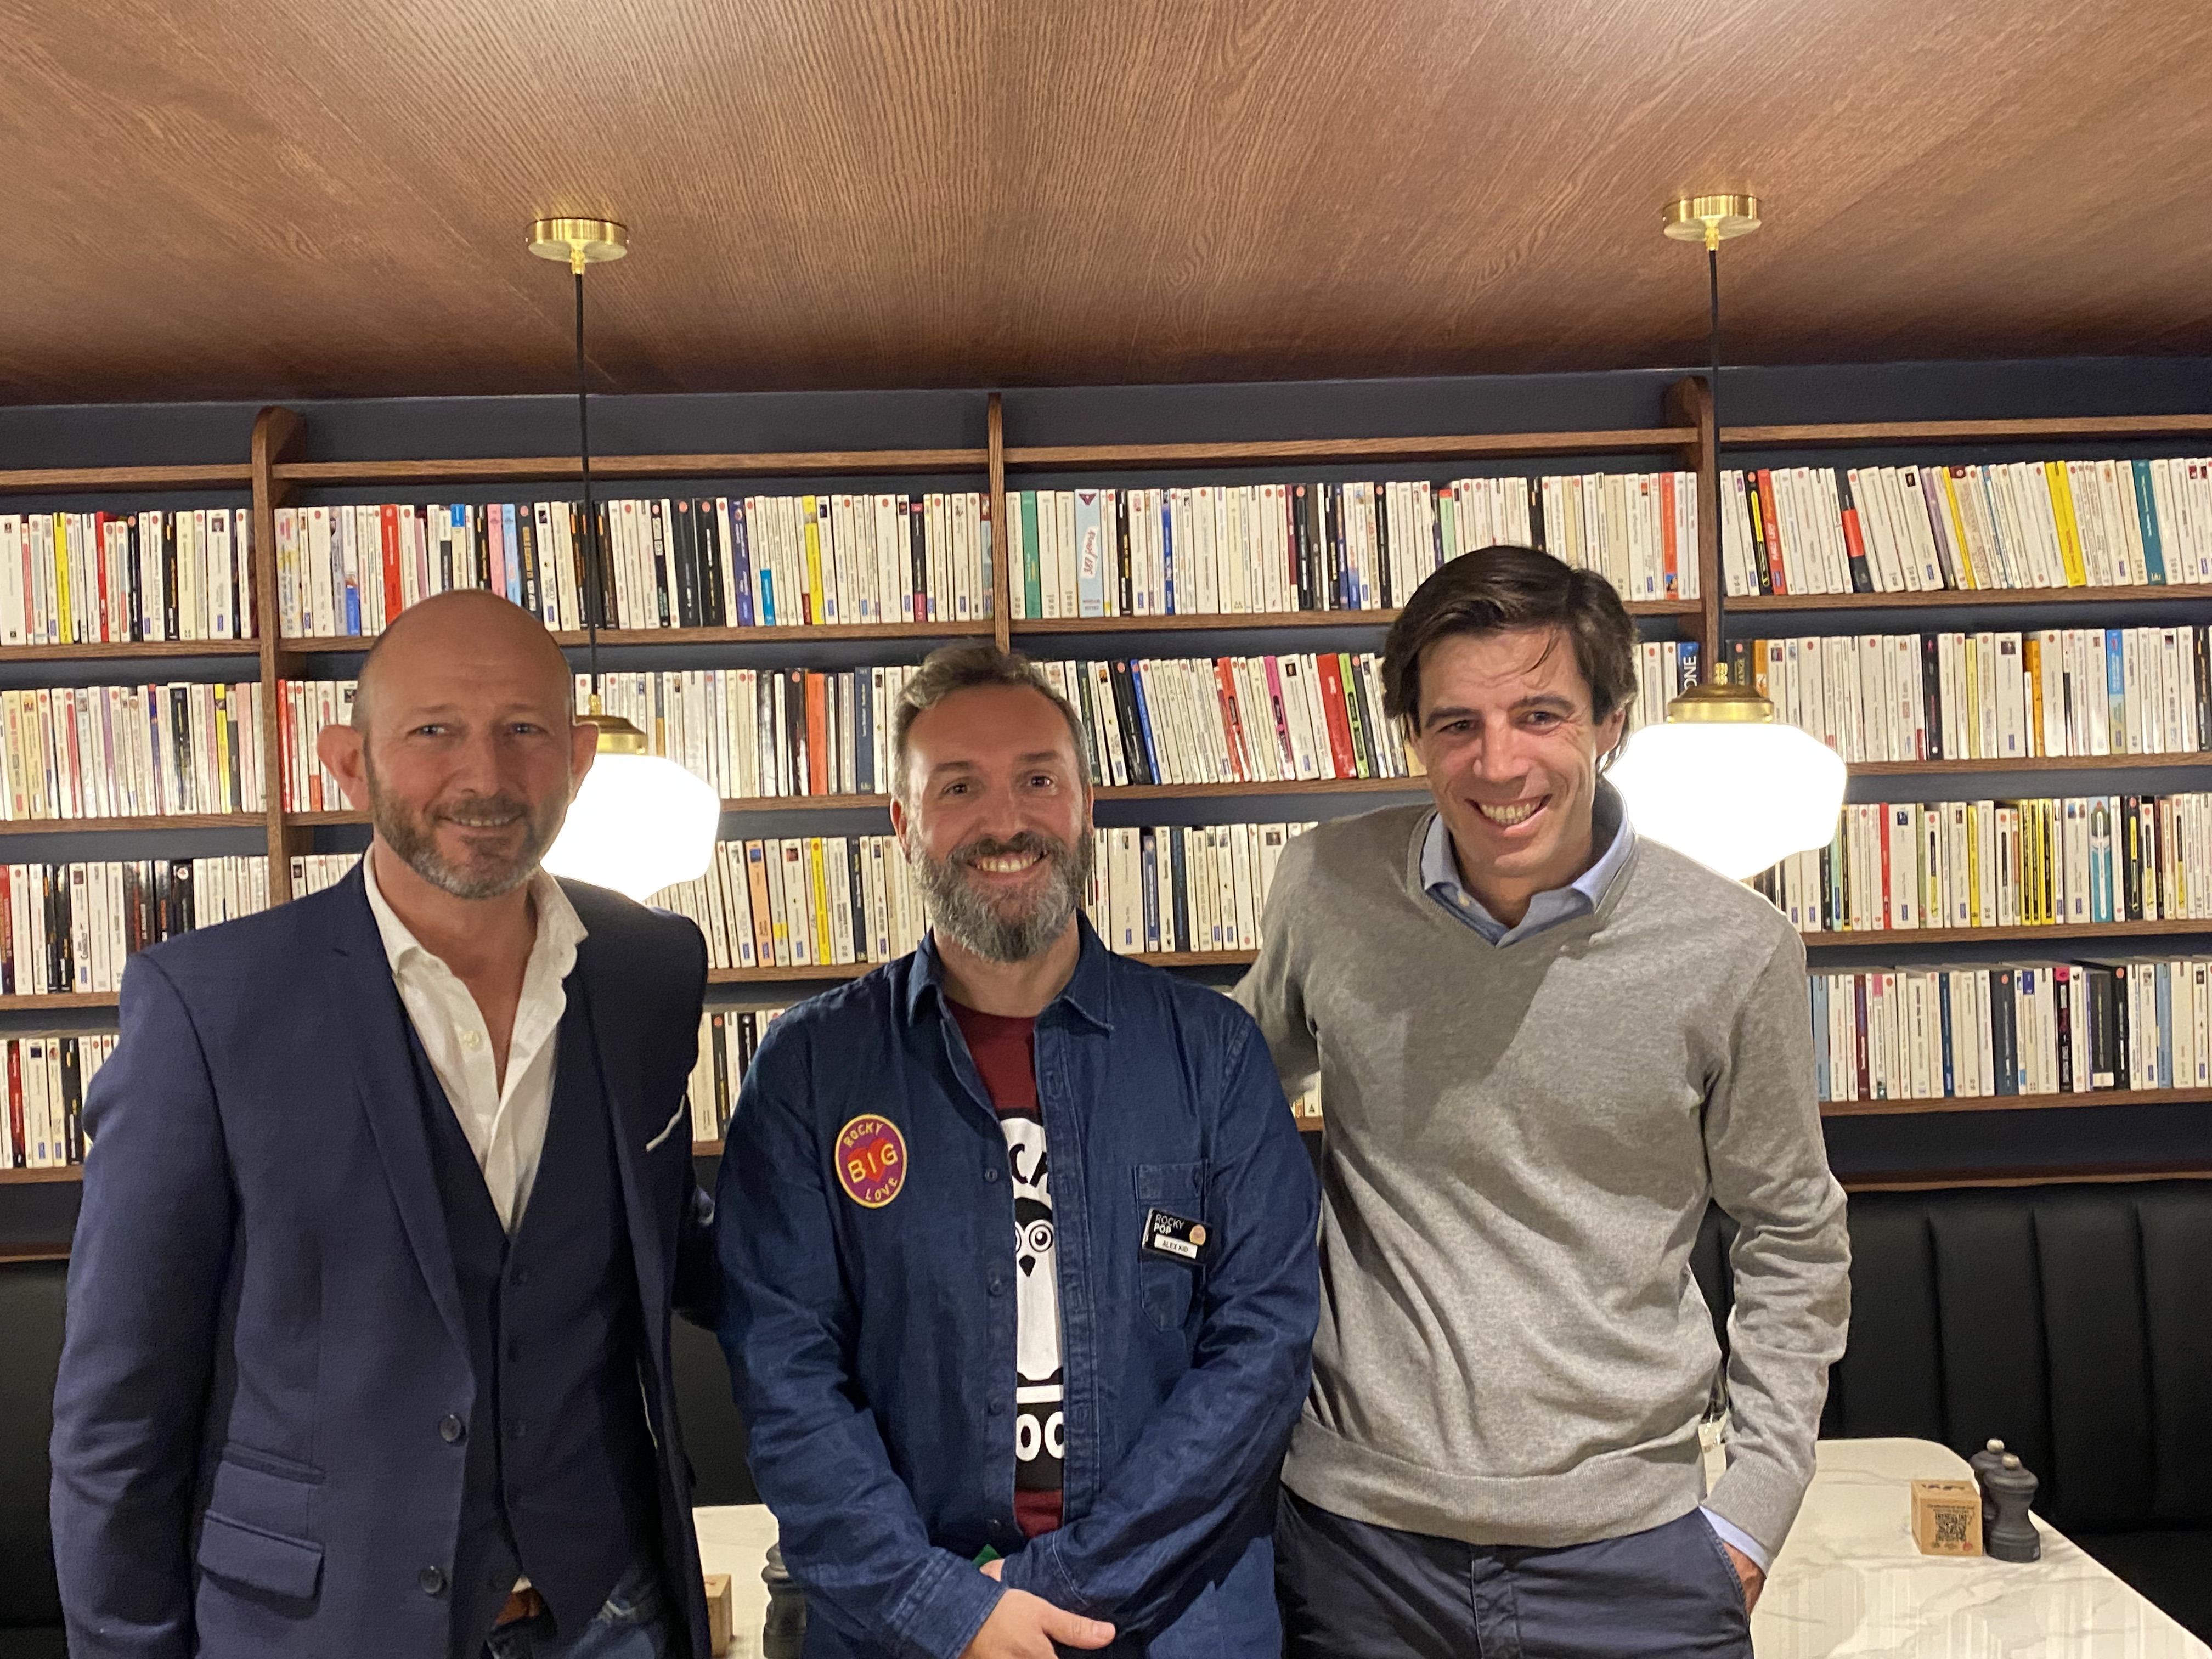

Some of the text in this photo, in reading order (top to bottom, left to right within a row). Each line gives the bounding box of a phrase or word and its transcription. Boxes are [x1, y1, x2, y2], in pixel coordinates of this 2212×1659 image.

[1084, 556, 1093, 575] 387
[843, 1122, 884, 1148] ROCKY
[847, 1143, 899, 1184] BIG
[865, 1177, 898, 1201] LOVE
[1154, 1222, 1172, 1234] POP
[1155, 1214, 1185, 1229] ROCKY
[1162, 1240, 1177, 1250] ALEX
